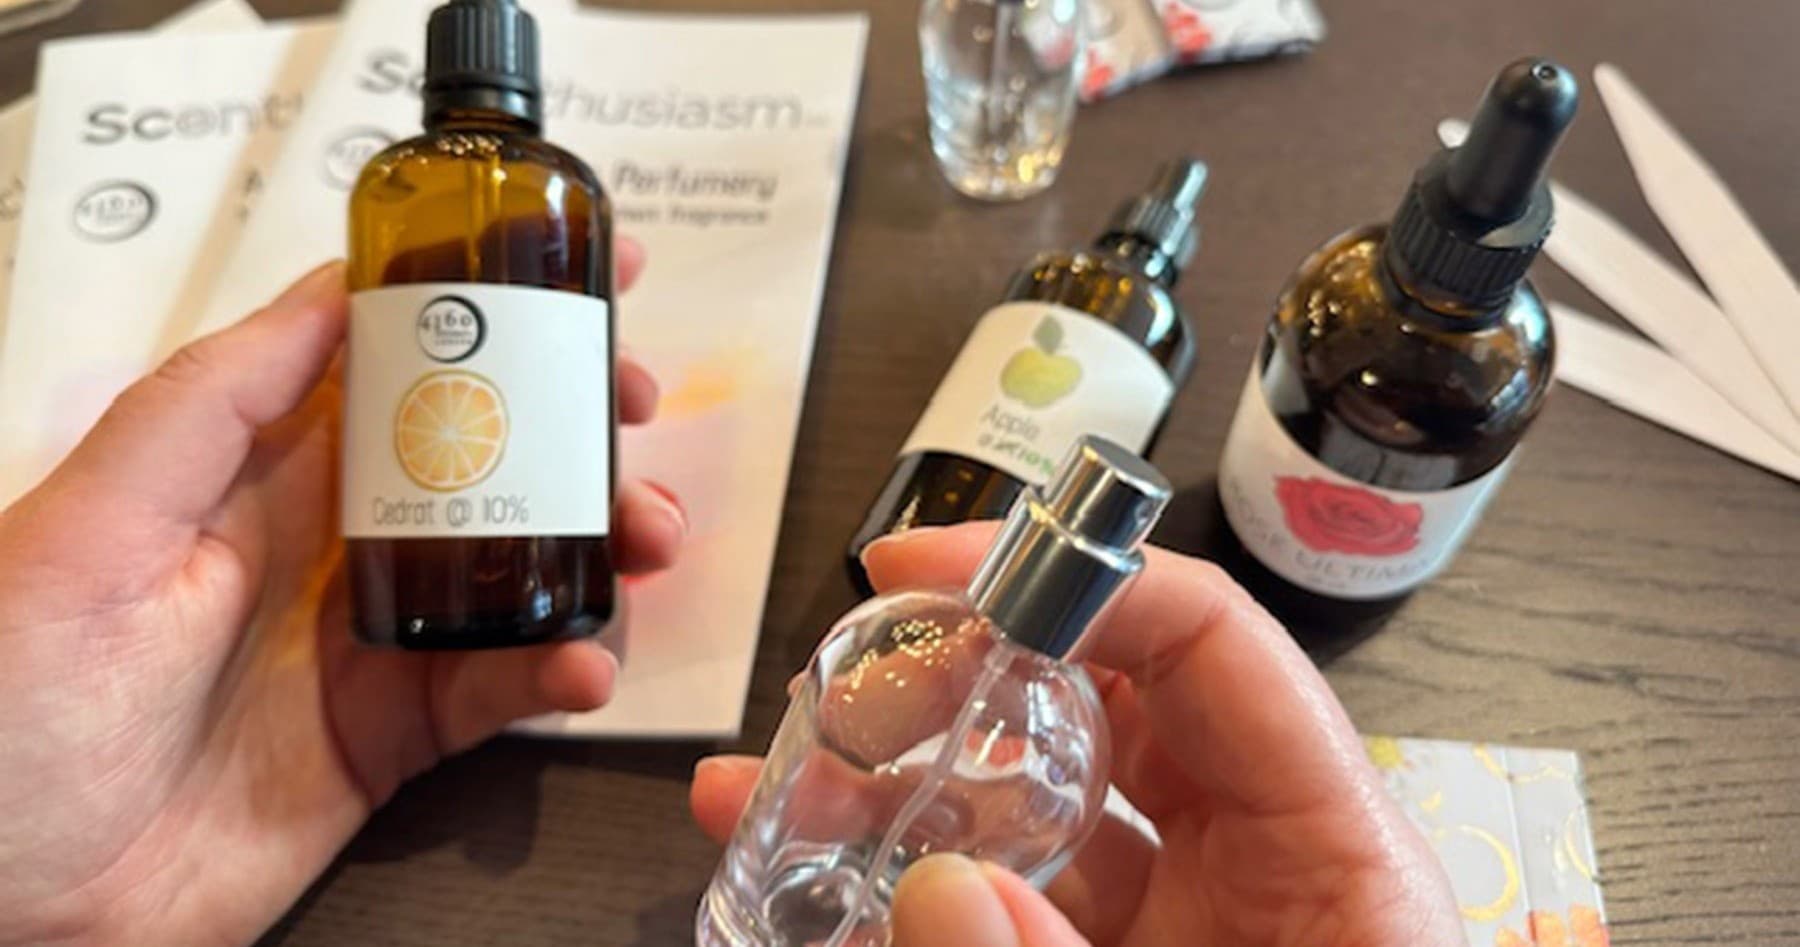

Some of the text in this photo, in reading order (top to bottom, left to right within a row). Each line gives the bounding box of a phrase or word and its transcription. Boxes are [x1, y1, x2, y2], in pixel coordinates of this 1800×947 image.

[978, 403, 1041, 441] Apple
[372, 495, 530, 528] Cedrat @ 10%
